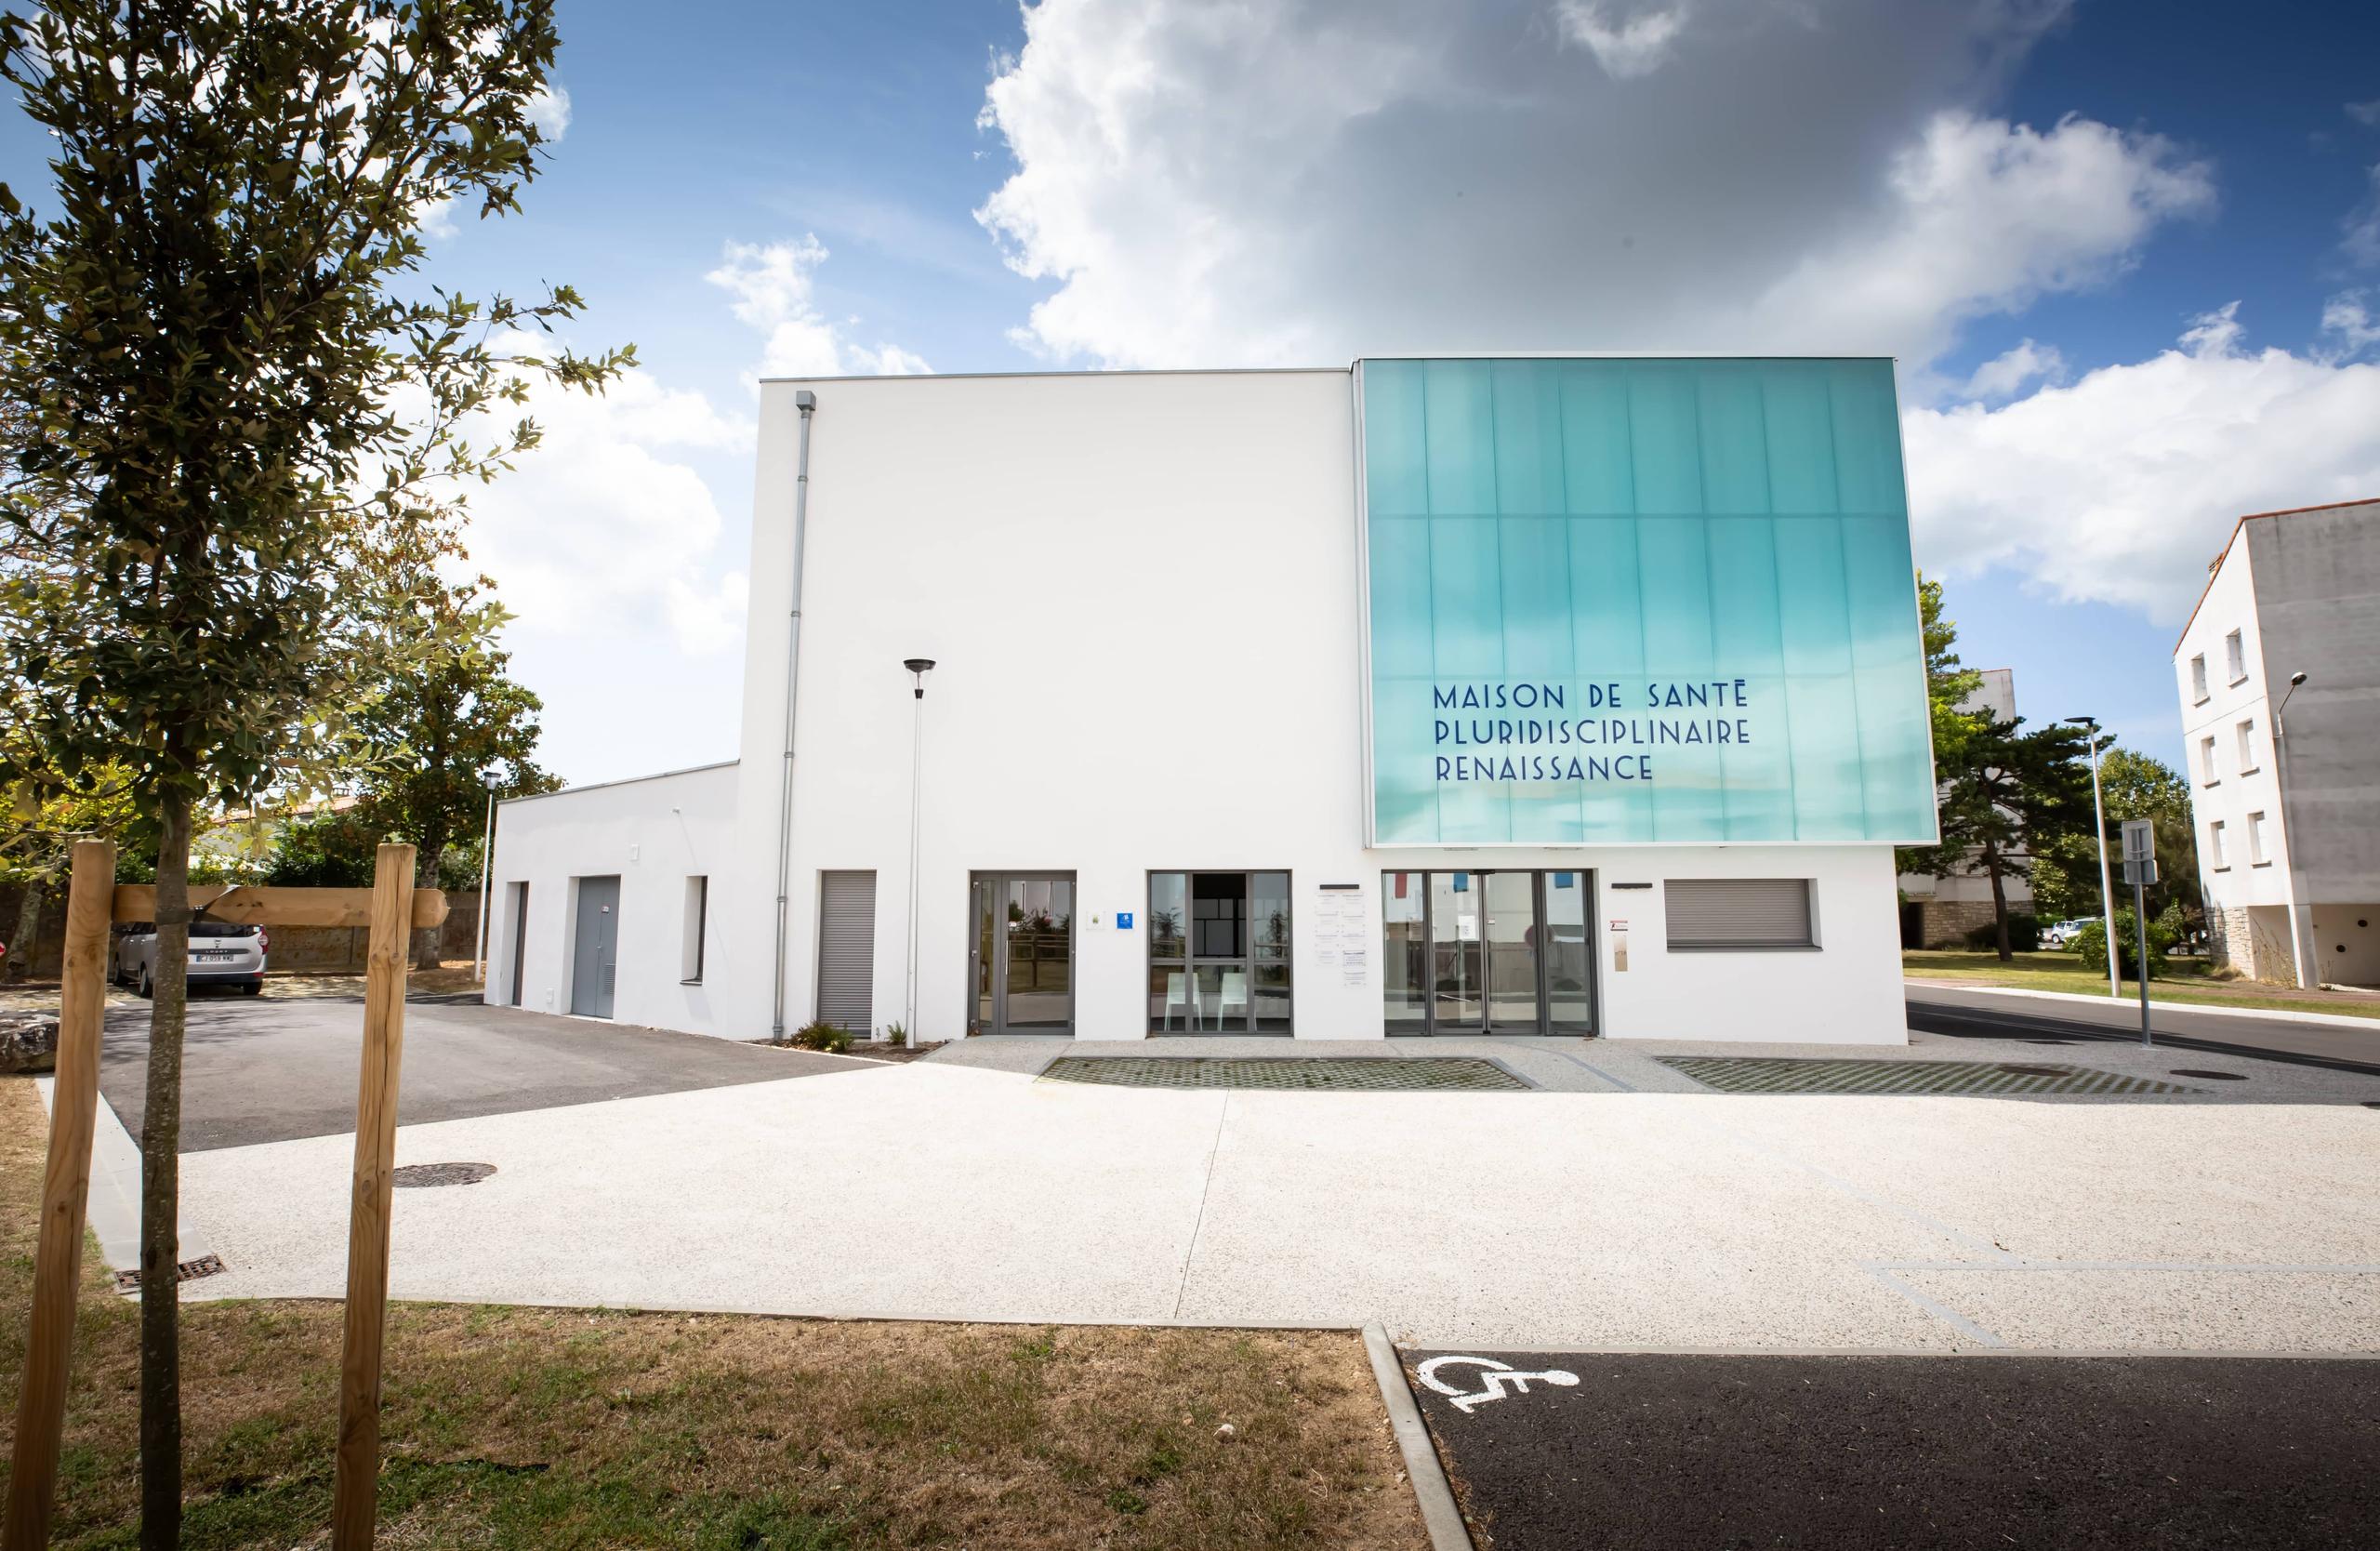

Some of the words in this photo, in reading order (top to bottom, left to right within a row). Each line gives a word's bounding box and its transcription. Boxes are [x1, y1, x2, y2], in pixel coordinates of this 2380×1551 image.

[1435, 683, 1564, 709] MAISON
[1590, 683, 1621, 708] DE
[1435, 720, 1750, 745] PLURIDISCIPLINAIRE
[1436, 755, 1653, 781] RENAISSANCE
